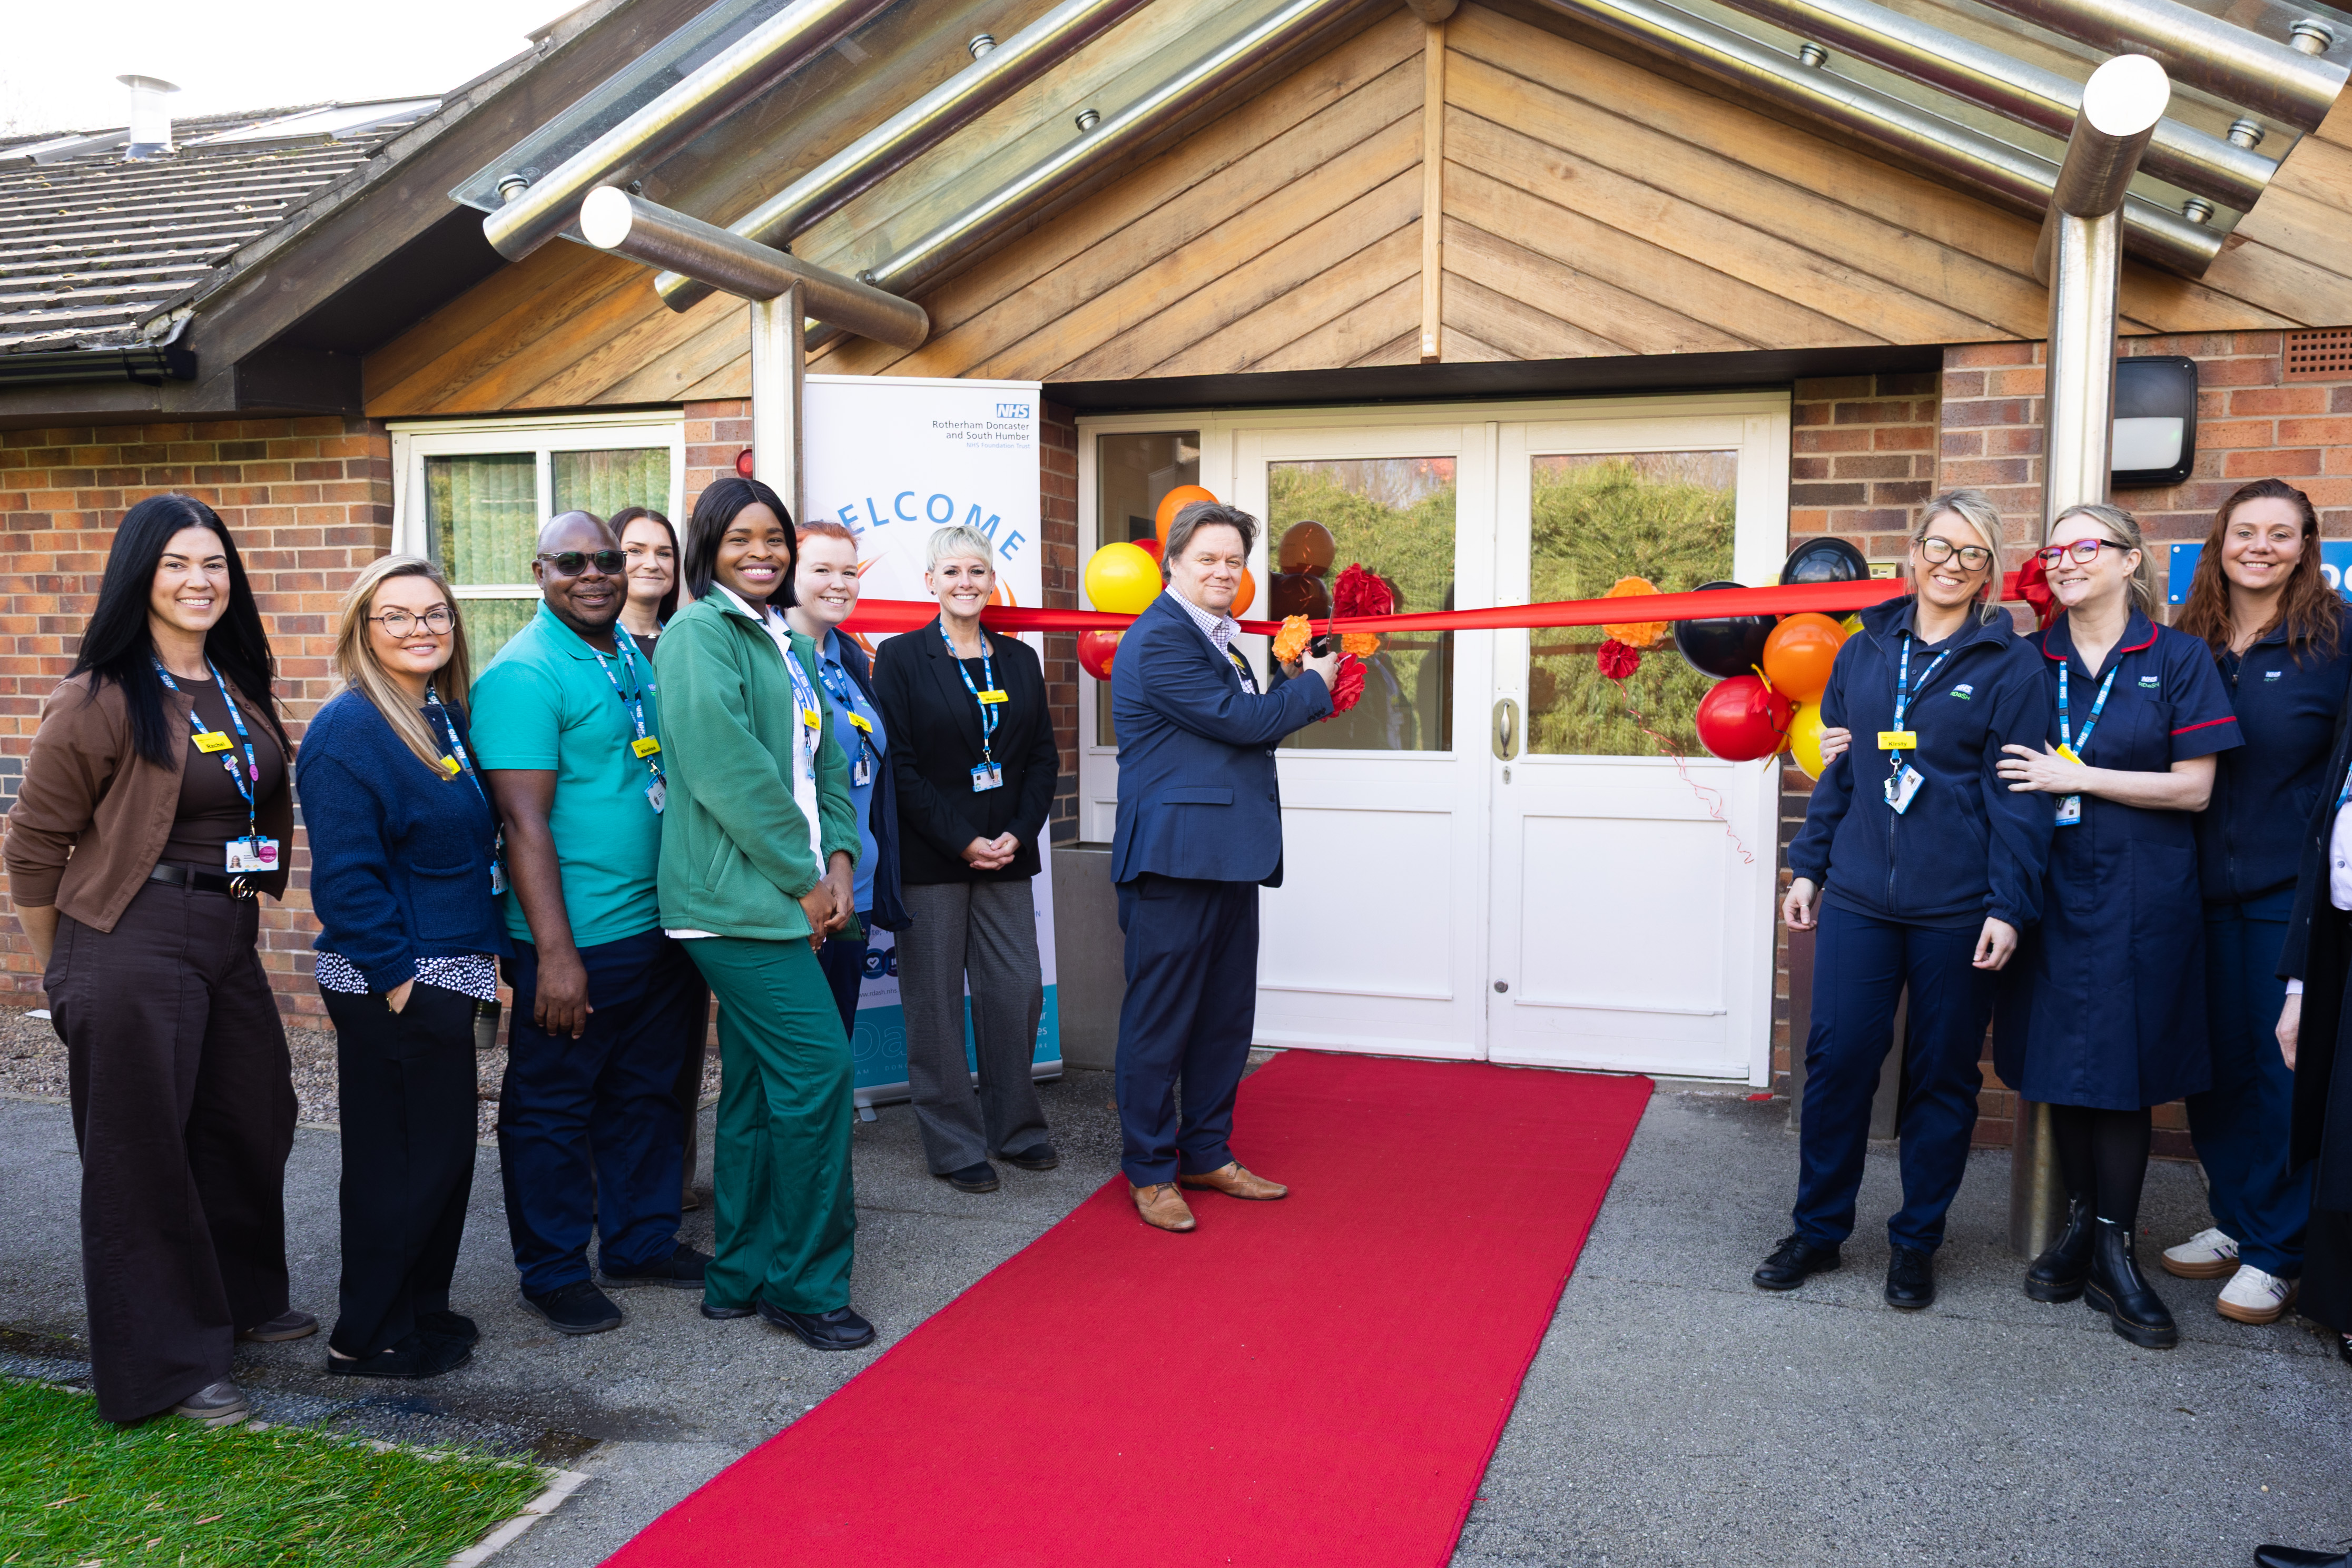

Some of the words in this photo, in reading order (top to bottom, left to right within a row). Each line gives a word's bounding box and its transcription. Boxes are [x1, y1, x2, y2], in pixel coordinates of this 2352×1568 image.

[997, 404, 1029, 418] NHS
[932, 420, 983, 429] Rotherham
[986, 421, 1030, 430] Doncaster
[820, 491, 1026, 561] ELCOME
[617, 641, 628, 651] NHS
[596, 655, 608, 668] NHS
[625, 654, 634, 666] NHS
[160, 675, 175, 688] NHS
[606, 671, 617, 684] NHS
[800, 676, 809, 687] NHS
[965, 677, 975, 688] NHS
[2104, 673, 2114, 686] NHS
[824, 679, 835, 691] NHS
[1953, 684, 1973, 695] NHS
[224, 693, 234, 707] NHS
[794, 688, 803, 700] NHS
[2097, 690, 2107, 705] NHS
[231, 711, 242, 725] NHS
[448, 728, 459, 742] NHS
[2076, 732, 2088, 747] NHS
[455, 745, 467, 759] NHS
[237, 780, 247, 794] NHS
